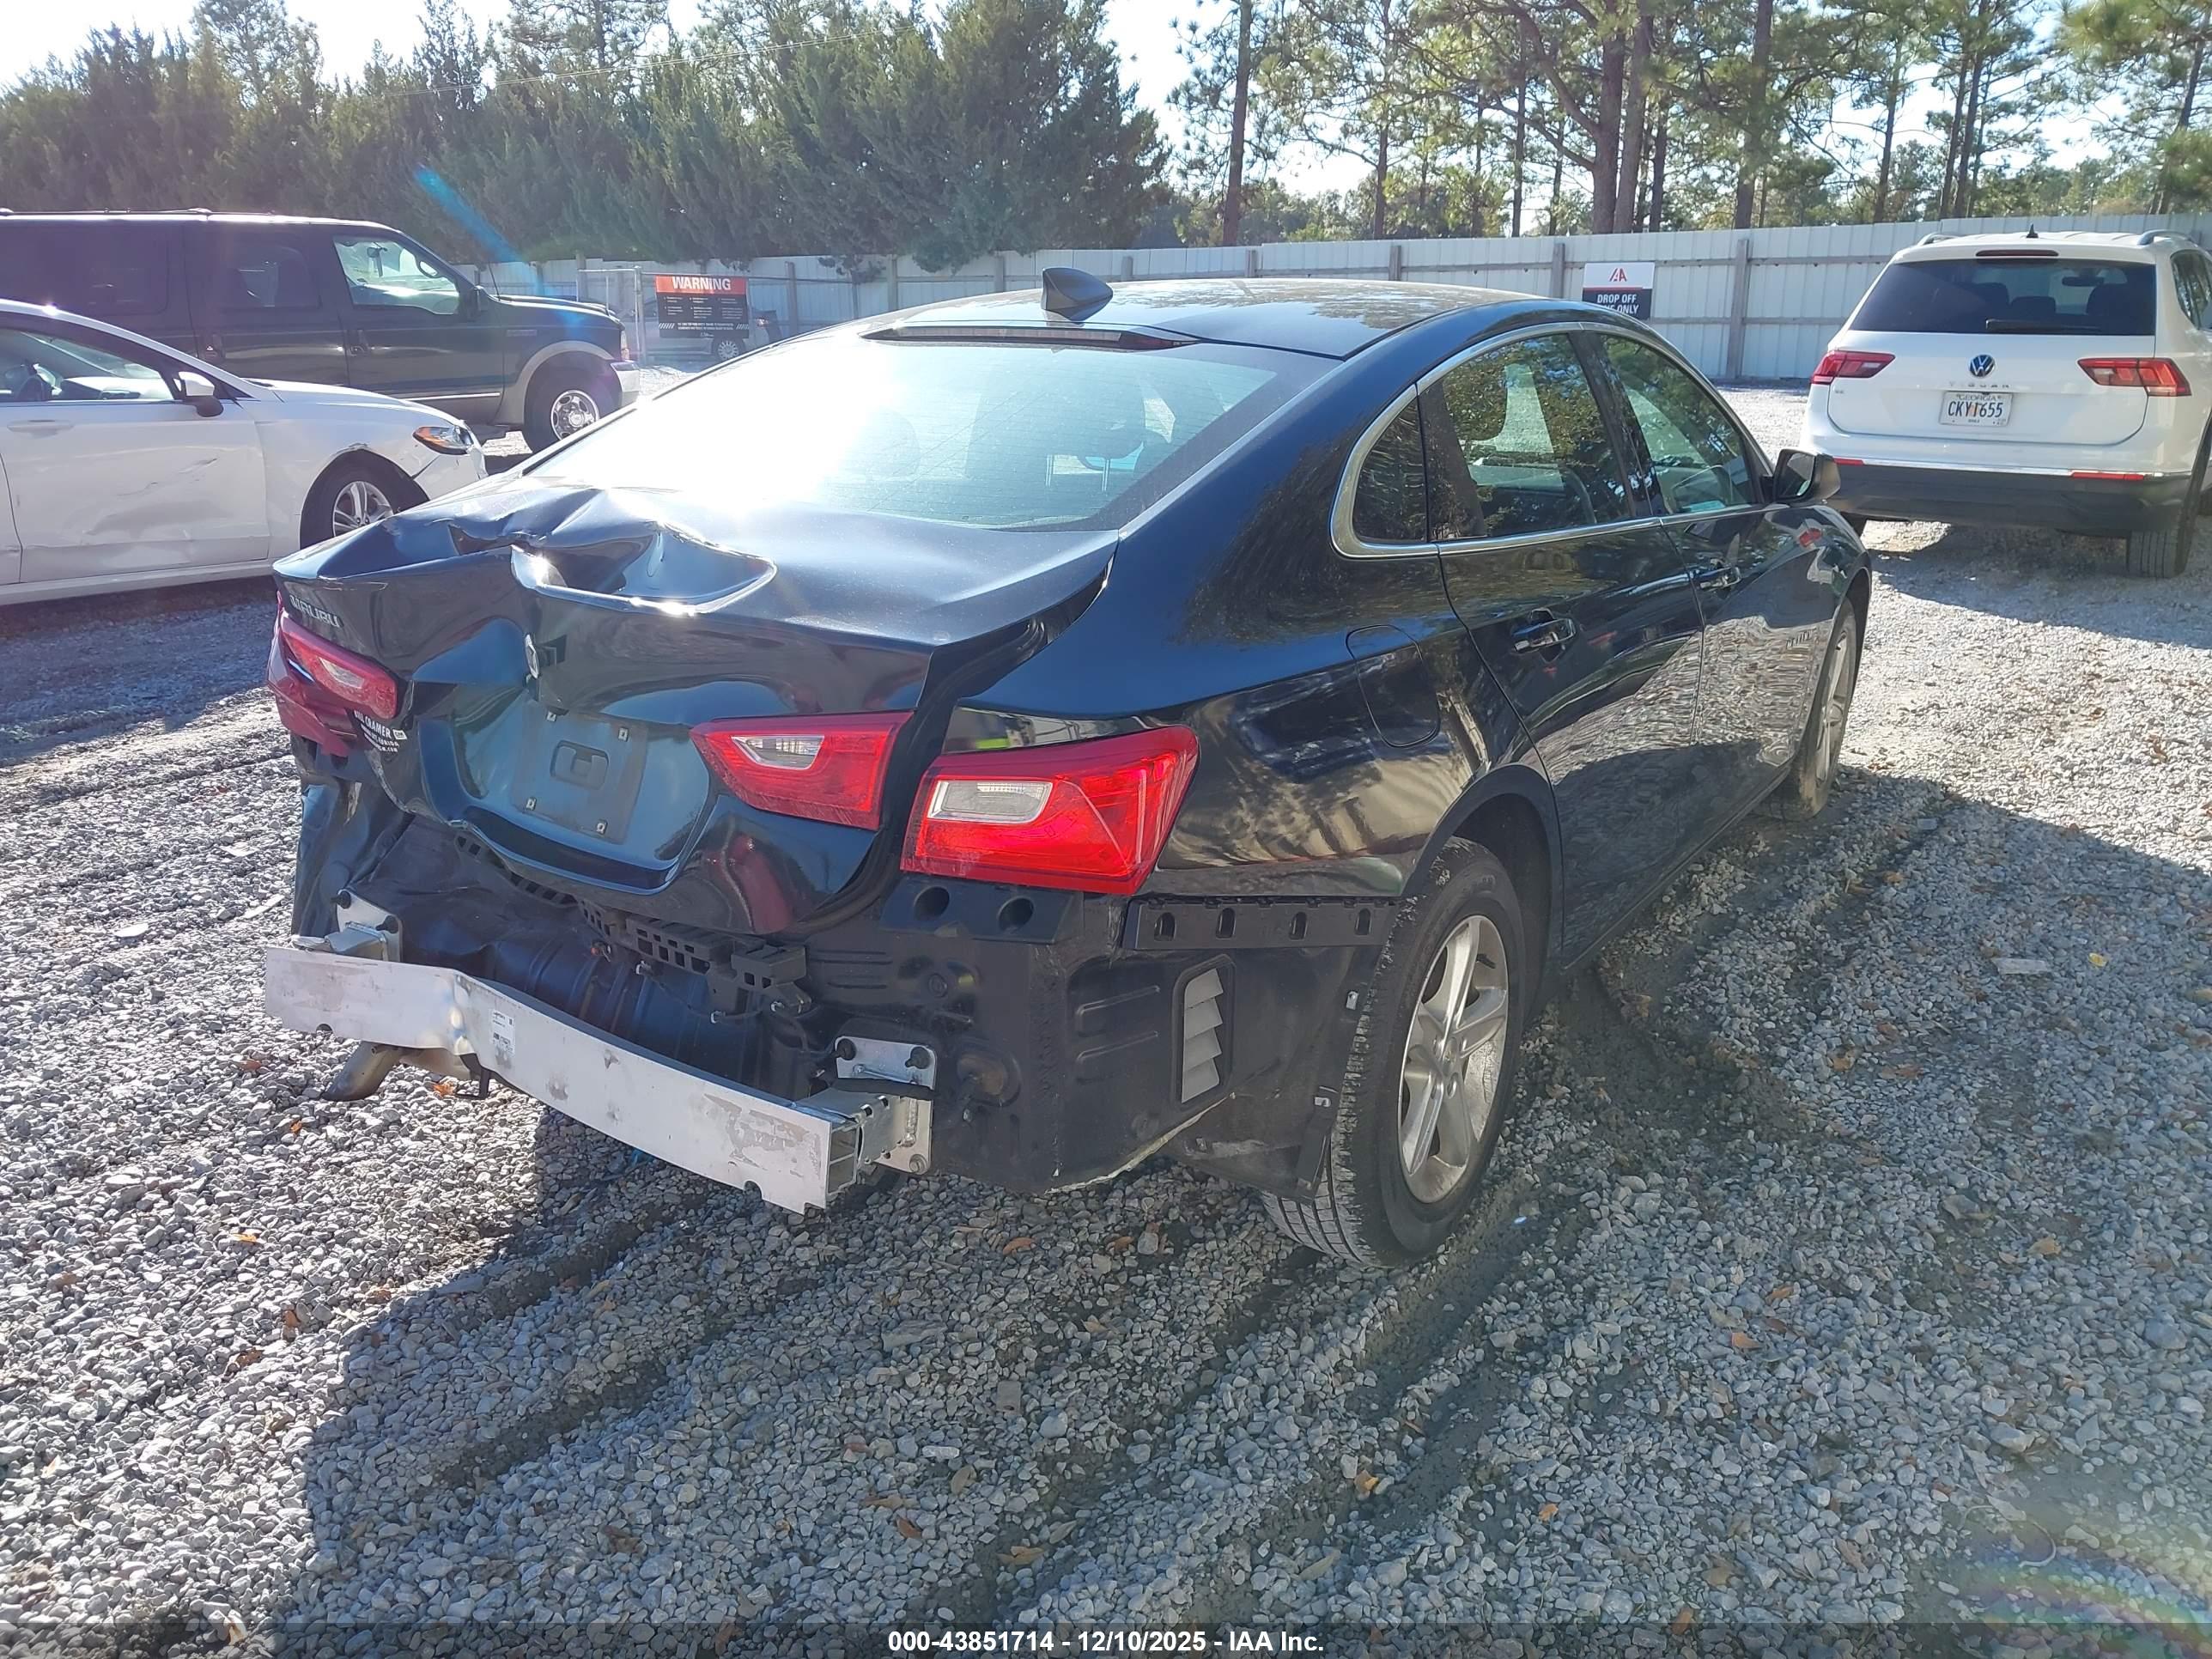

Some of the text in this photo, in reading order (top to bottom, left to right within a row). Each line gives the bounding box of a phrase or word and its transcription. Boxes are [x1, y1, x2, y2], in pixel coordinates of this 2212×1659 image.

[672, 276, 732, 290] WARNING
[1597, 294, 1638, 304] DROP OFF
[1617, 304, 1639, 314] ONLY
[365, 716, 392, 739] CRAMER
